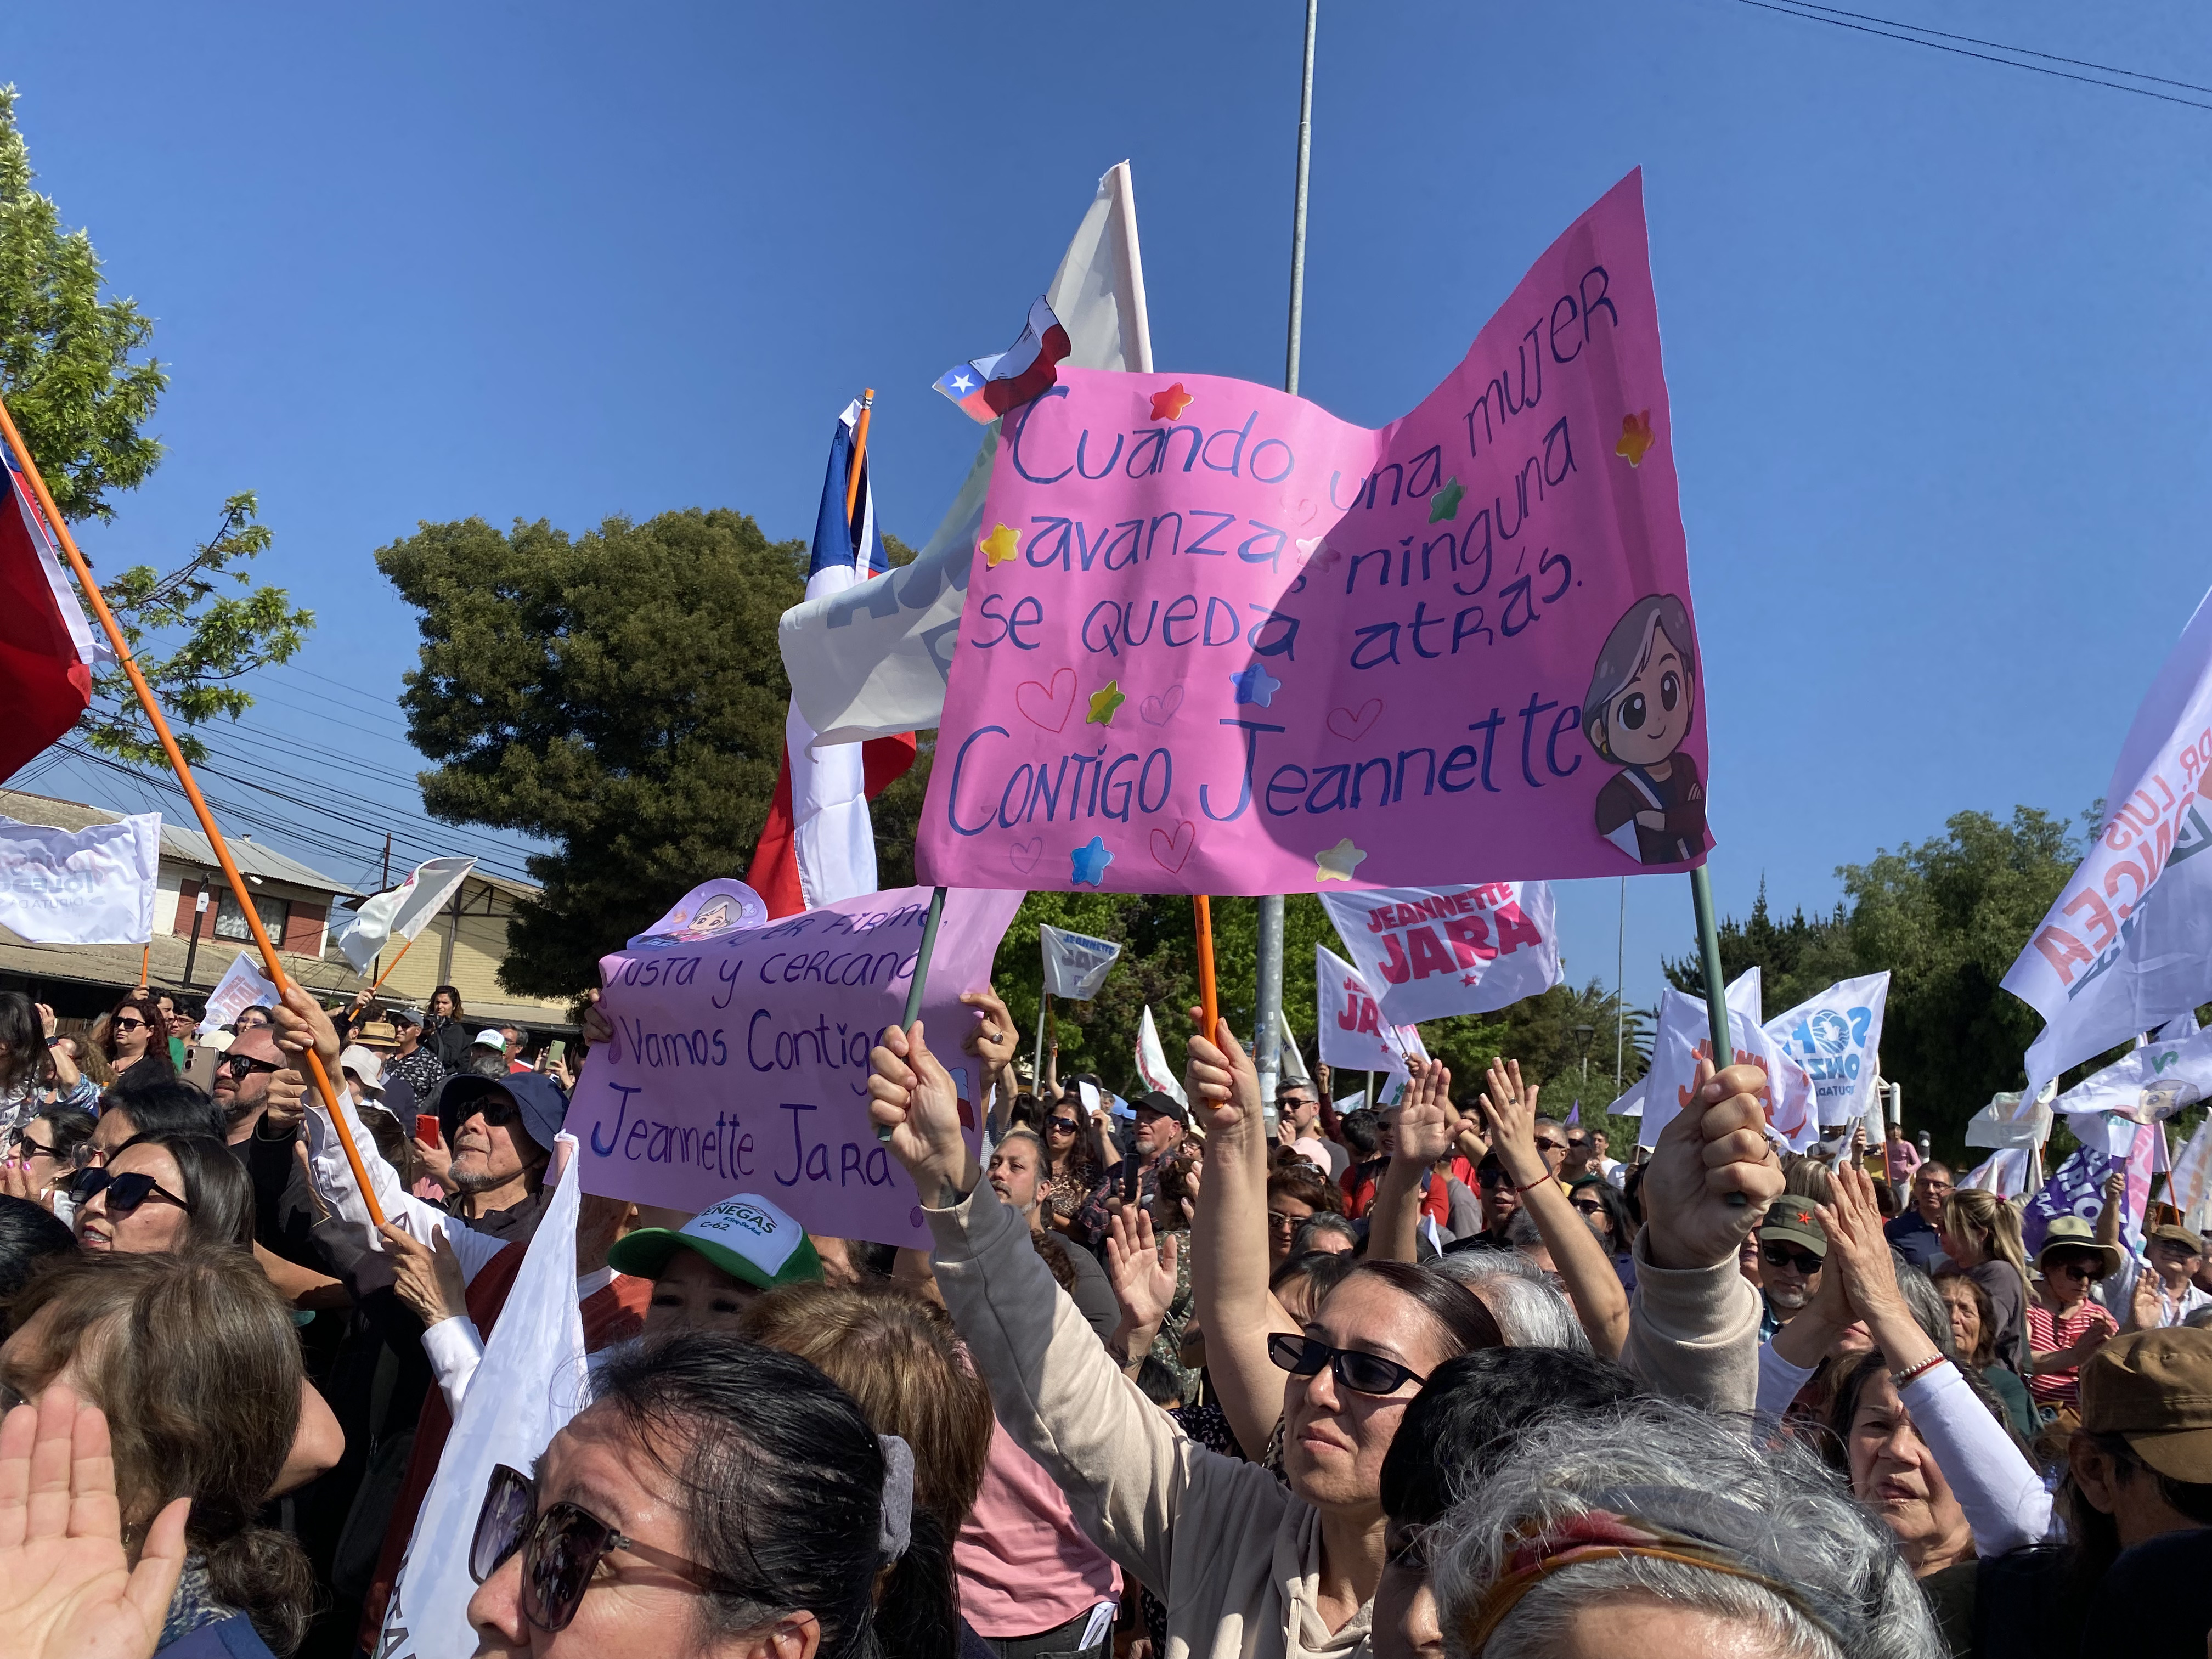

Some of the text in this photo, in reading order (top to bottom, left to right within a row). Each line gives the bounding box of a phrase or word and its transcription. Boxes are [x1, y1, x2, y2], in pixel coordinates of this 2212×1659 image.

[1012, 385, 1295, 484] Cuando
[1329, 443, 1442, 512] una
[1344, 414, 1578, 596] ninguna
[970, 592, 1044, 650] se
[1199, 692, 1583, 823] Jeannette
[1367, 881, 1514, 933] JEANNETTE
[1378, 900, 1542, 985] JARA
[711, 959, 743, 1009] y
[1338, 993, 1383, 1038] JA
[619, 1008, 887, 1097] Vamos Contig
[590, 1081, 755, 1180] Jeannette
[699, 1221, 730, 1231] C-62
[700, 1204, 777, 1234] ENEGAS
